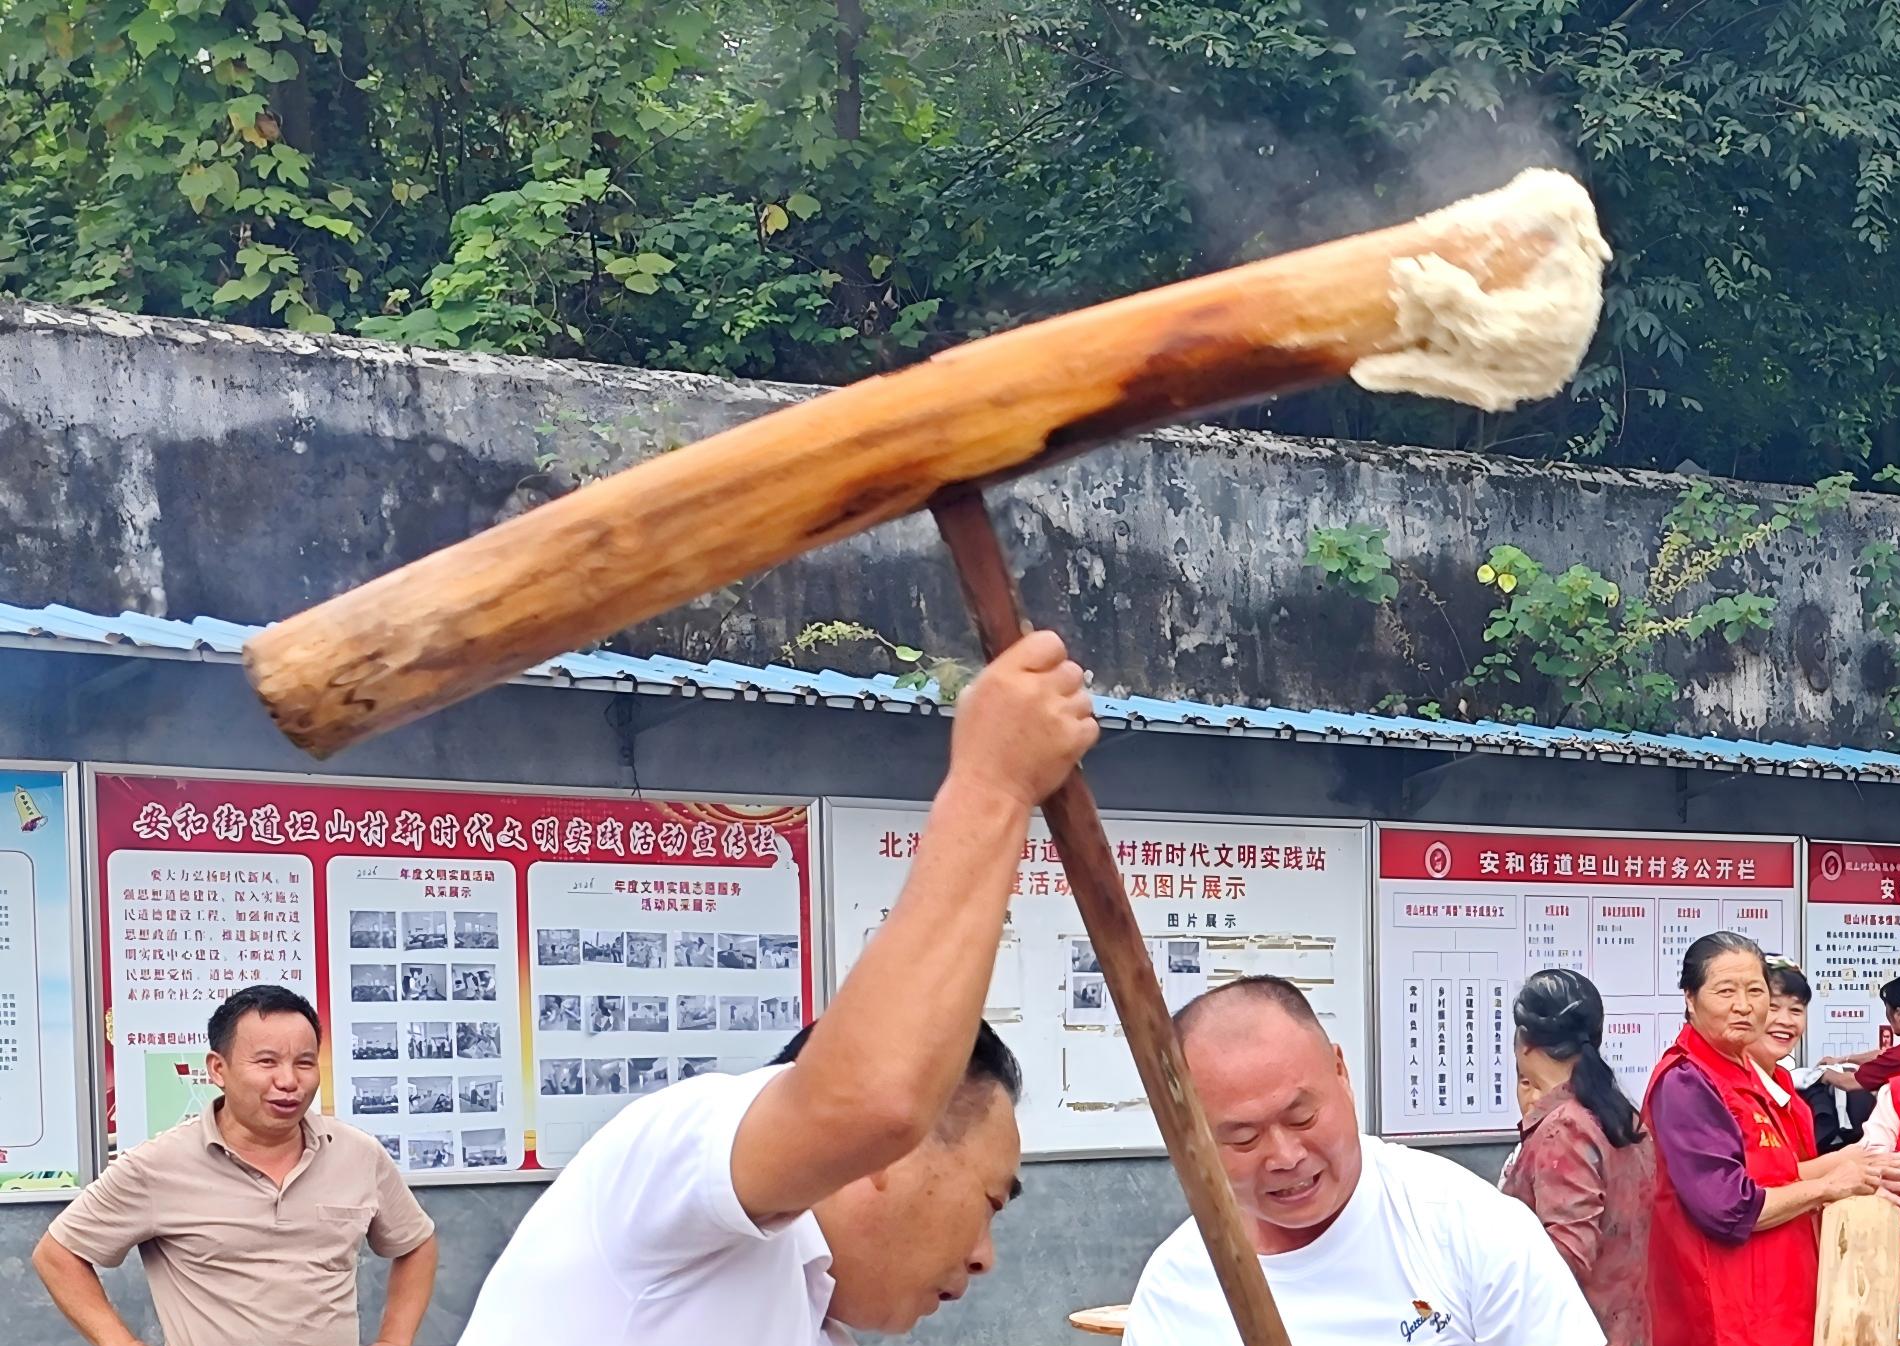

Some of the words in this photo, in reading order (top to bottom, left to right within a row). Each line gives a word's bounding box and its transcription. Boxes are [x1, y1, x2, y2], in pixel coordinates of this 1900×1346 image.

[133, 802, 781, 860] 安和街道坦山村新时代文明实践活动宣传栏
[1479, 850, 1756, 880] 安和街道坦山村村务公开栏
[1167, 913, 1236, 929] 图片展示
